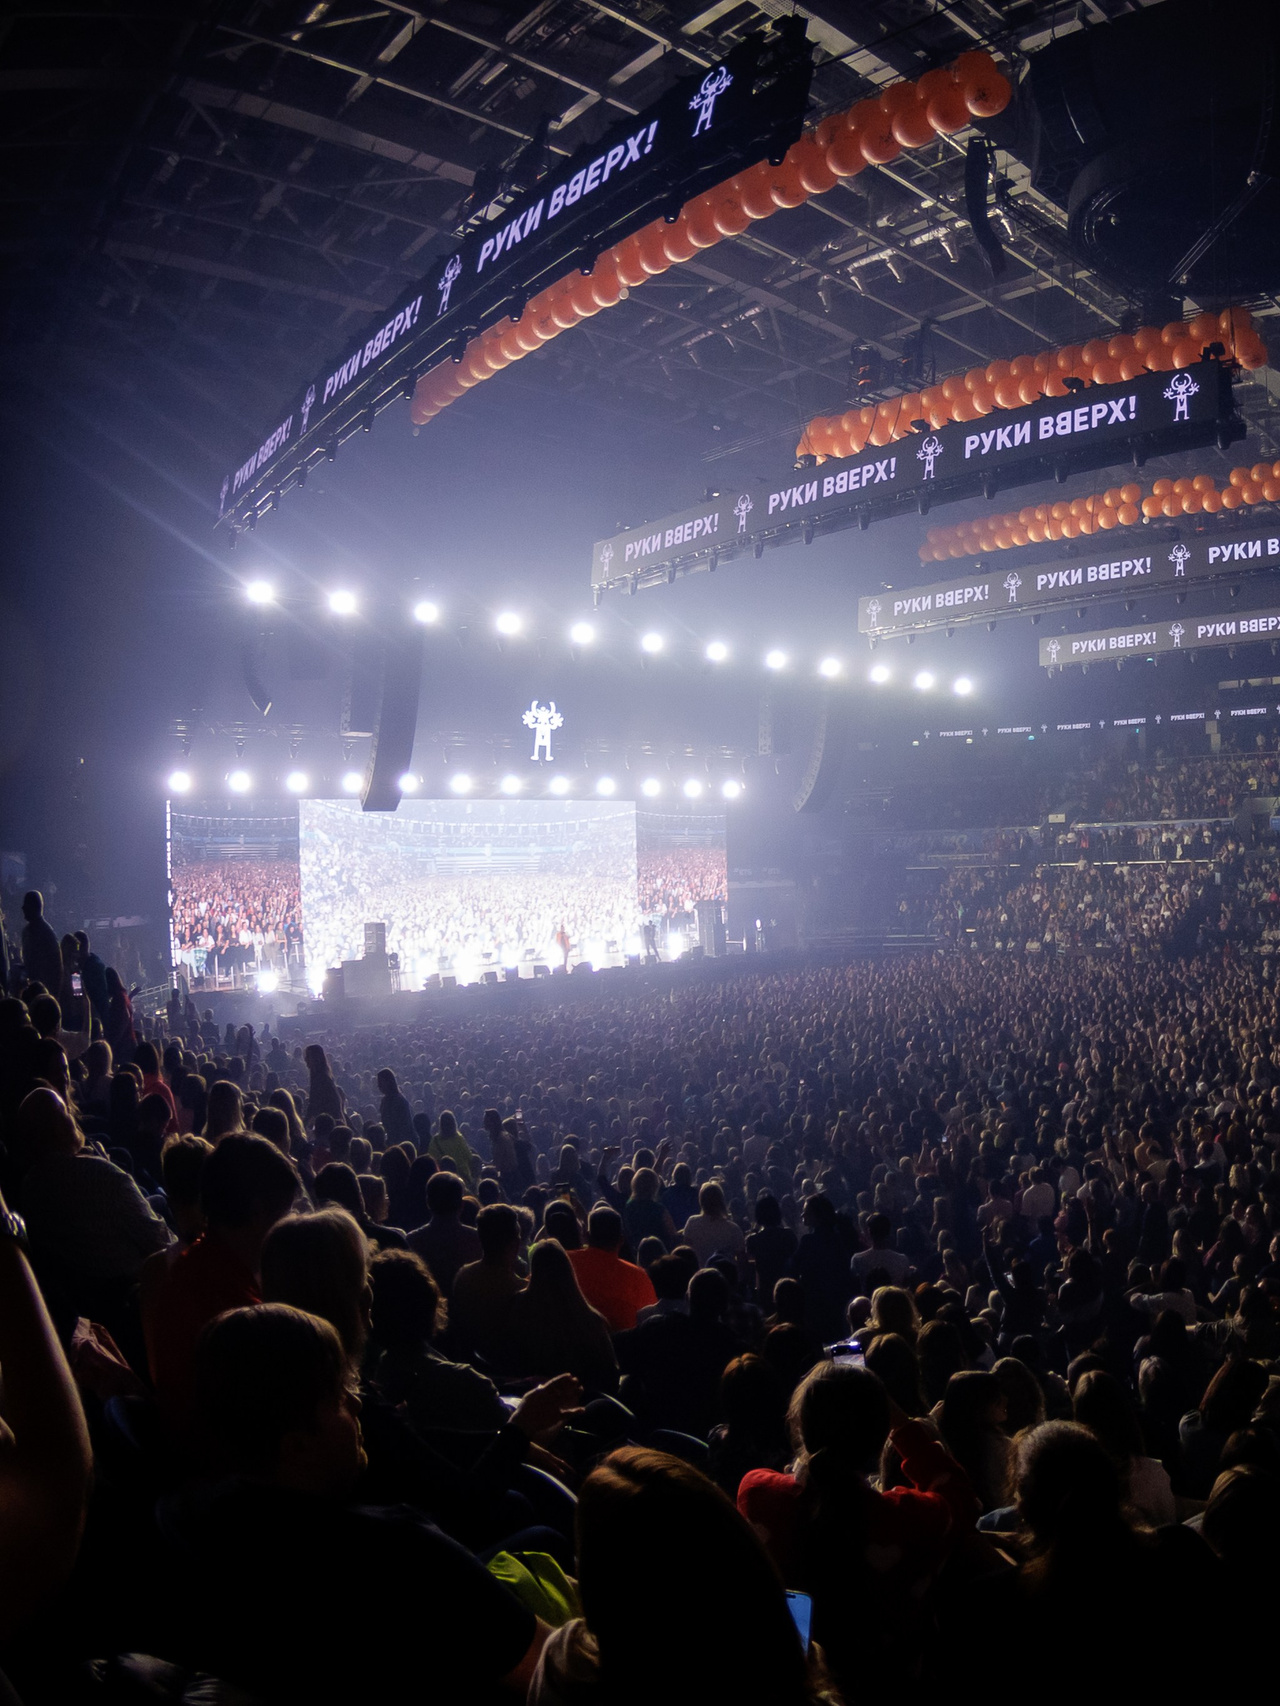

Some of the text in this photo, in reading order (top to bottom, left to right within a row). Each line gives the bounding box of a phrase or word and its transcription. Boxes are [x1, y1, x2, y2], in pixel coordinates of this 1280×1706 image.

[476, 120, 659, 274] РУКИ ВВЕРХ!
[322, 295, 423, 405] РУКИ ВВЕРХ!
[964, 395, 1137, 459] РУКИ ВВЕРХ!
[232, 451, 258, 495] РУКИ
[768, 456, 897, 515] РУКИ ВВЕРХ!
[624, 512, 719, 562] РУКИ ВВЕРХ!
[1208, 539, 1262, 564] РУКИ
[1037, 556, 1152, 591] РУКИ ВВЕРХ!
[893, 584, 990, 617] РУКИ ВВЕРХ!
[1071, 631, 1157, 655] РУКИ ВВЕРХ!
[1197, 621, 1236, 639] РУКИ
